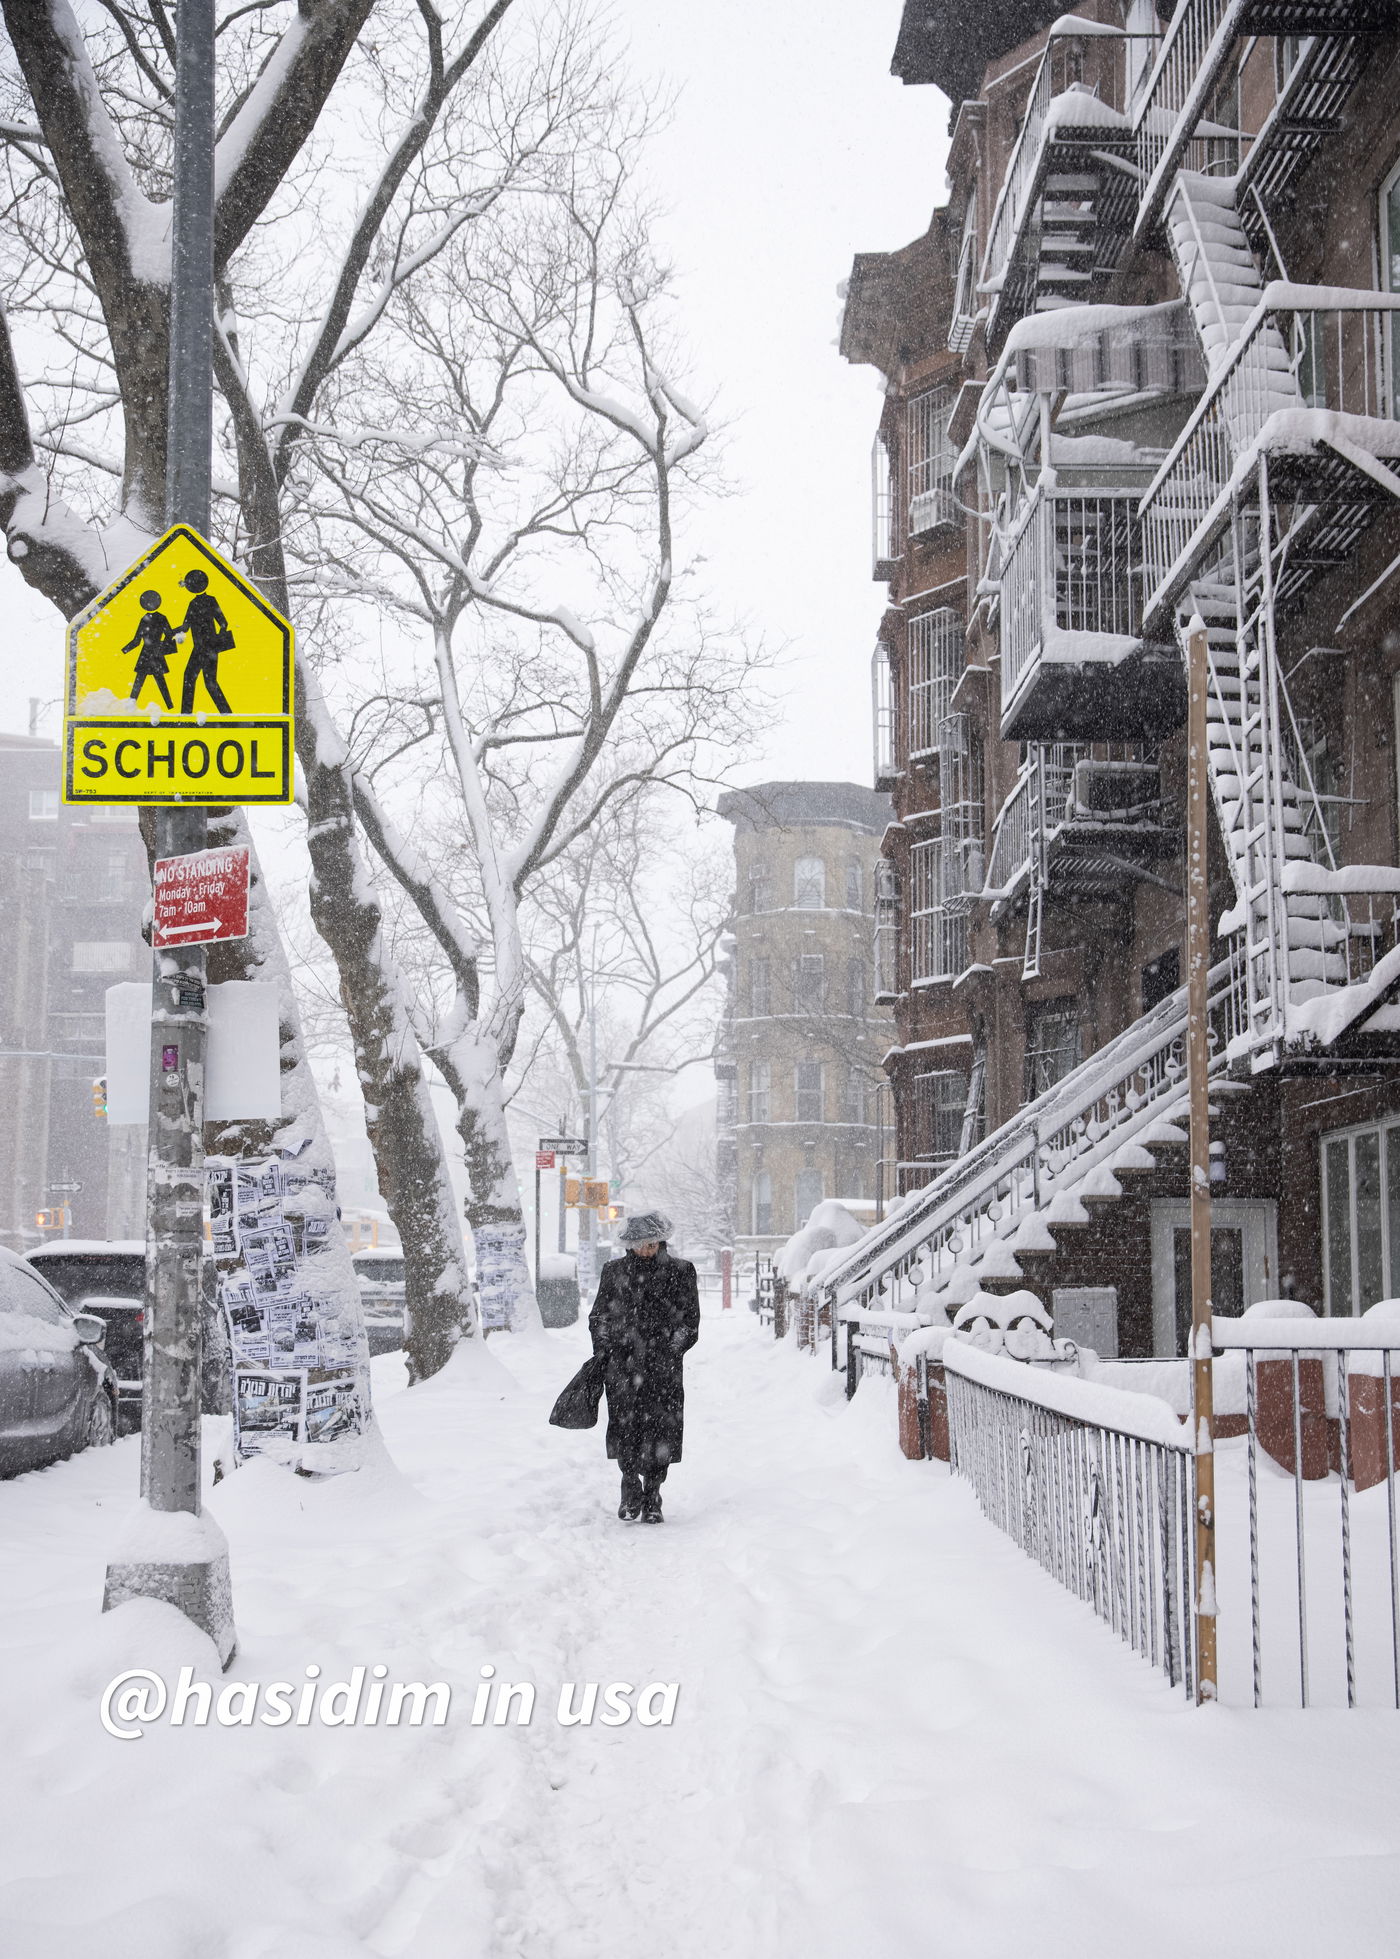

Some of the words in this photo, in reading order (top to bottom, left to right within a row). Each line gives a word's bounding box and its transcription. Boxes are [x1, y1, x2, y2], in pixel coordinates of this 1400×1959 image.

[81, 739, 275, 779] SCHOOL
[160, 866, 175, 884] NO
[178, 856, 233, 880] STANDING
[159, 885, 191, 901] Monday
[199, 880, 225, 896] Friday
[159, 904, 177, 918] 7am
[184, 900, 206, 914] 10am
[546, 1143, 560, 1151] ONE
[567, 1143, 582, 1151] WAY
